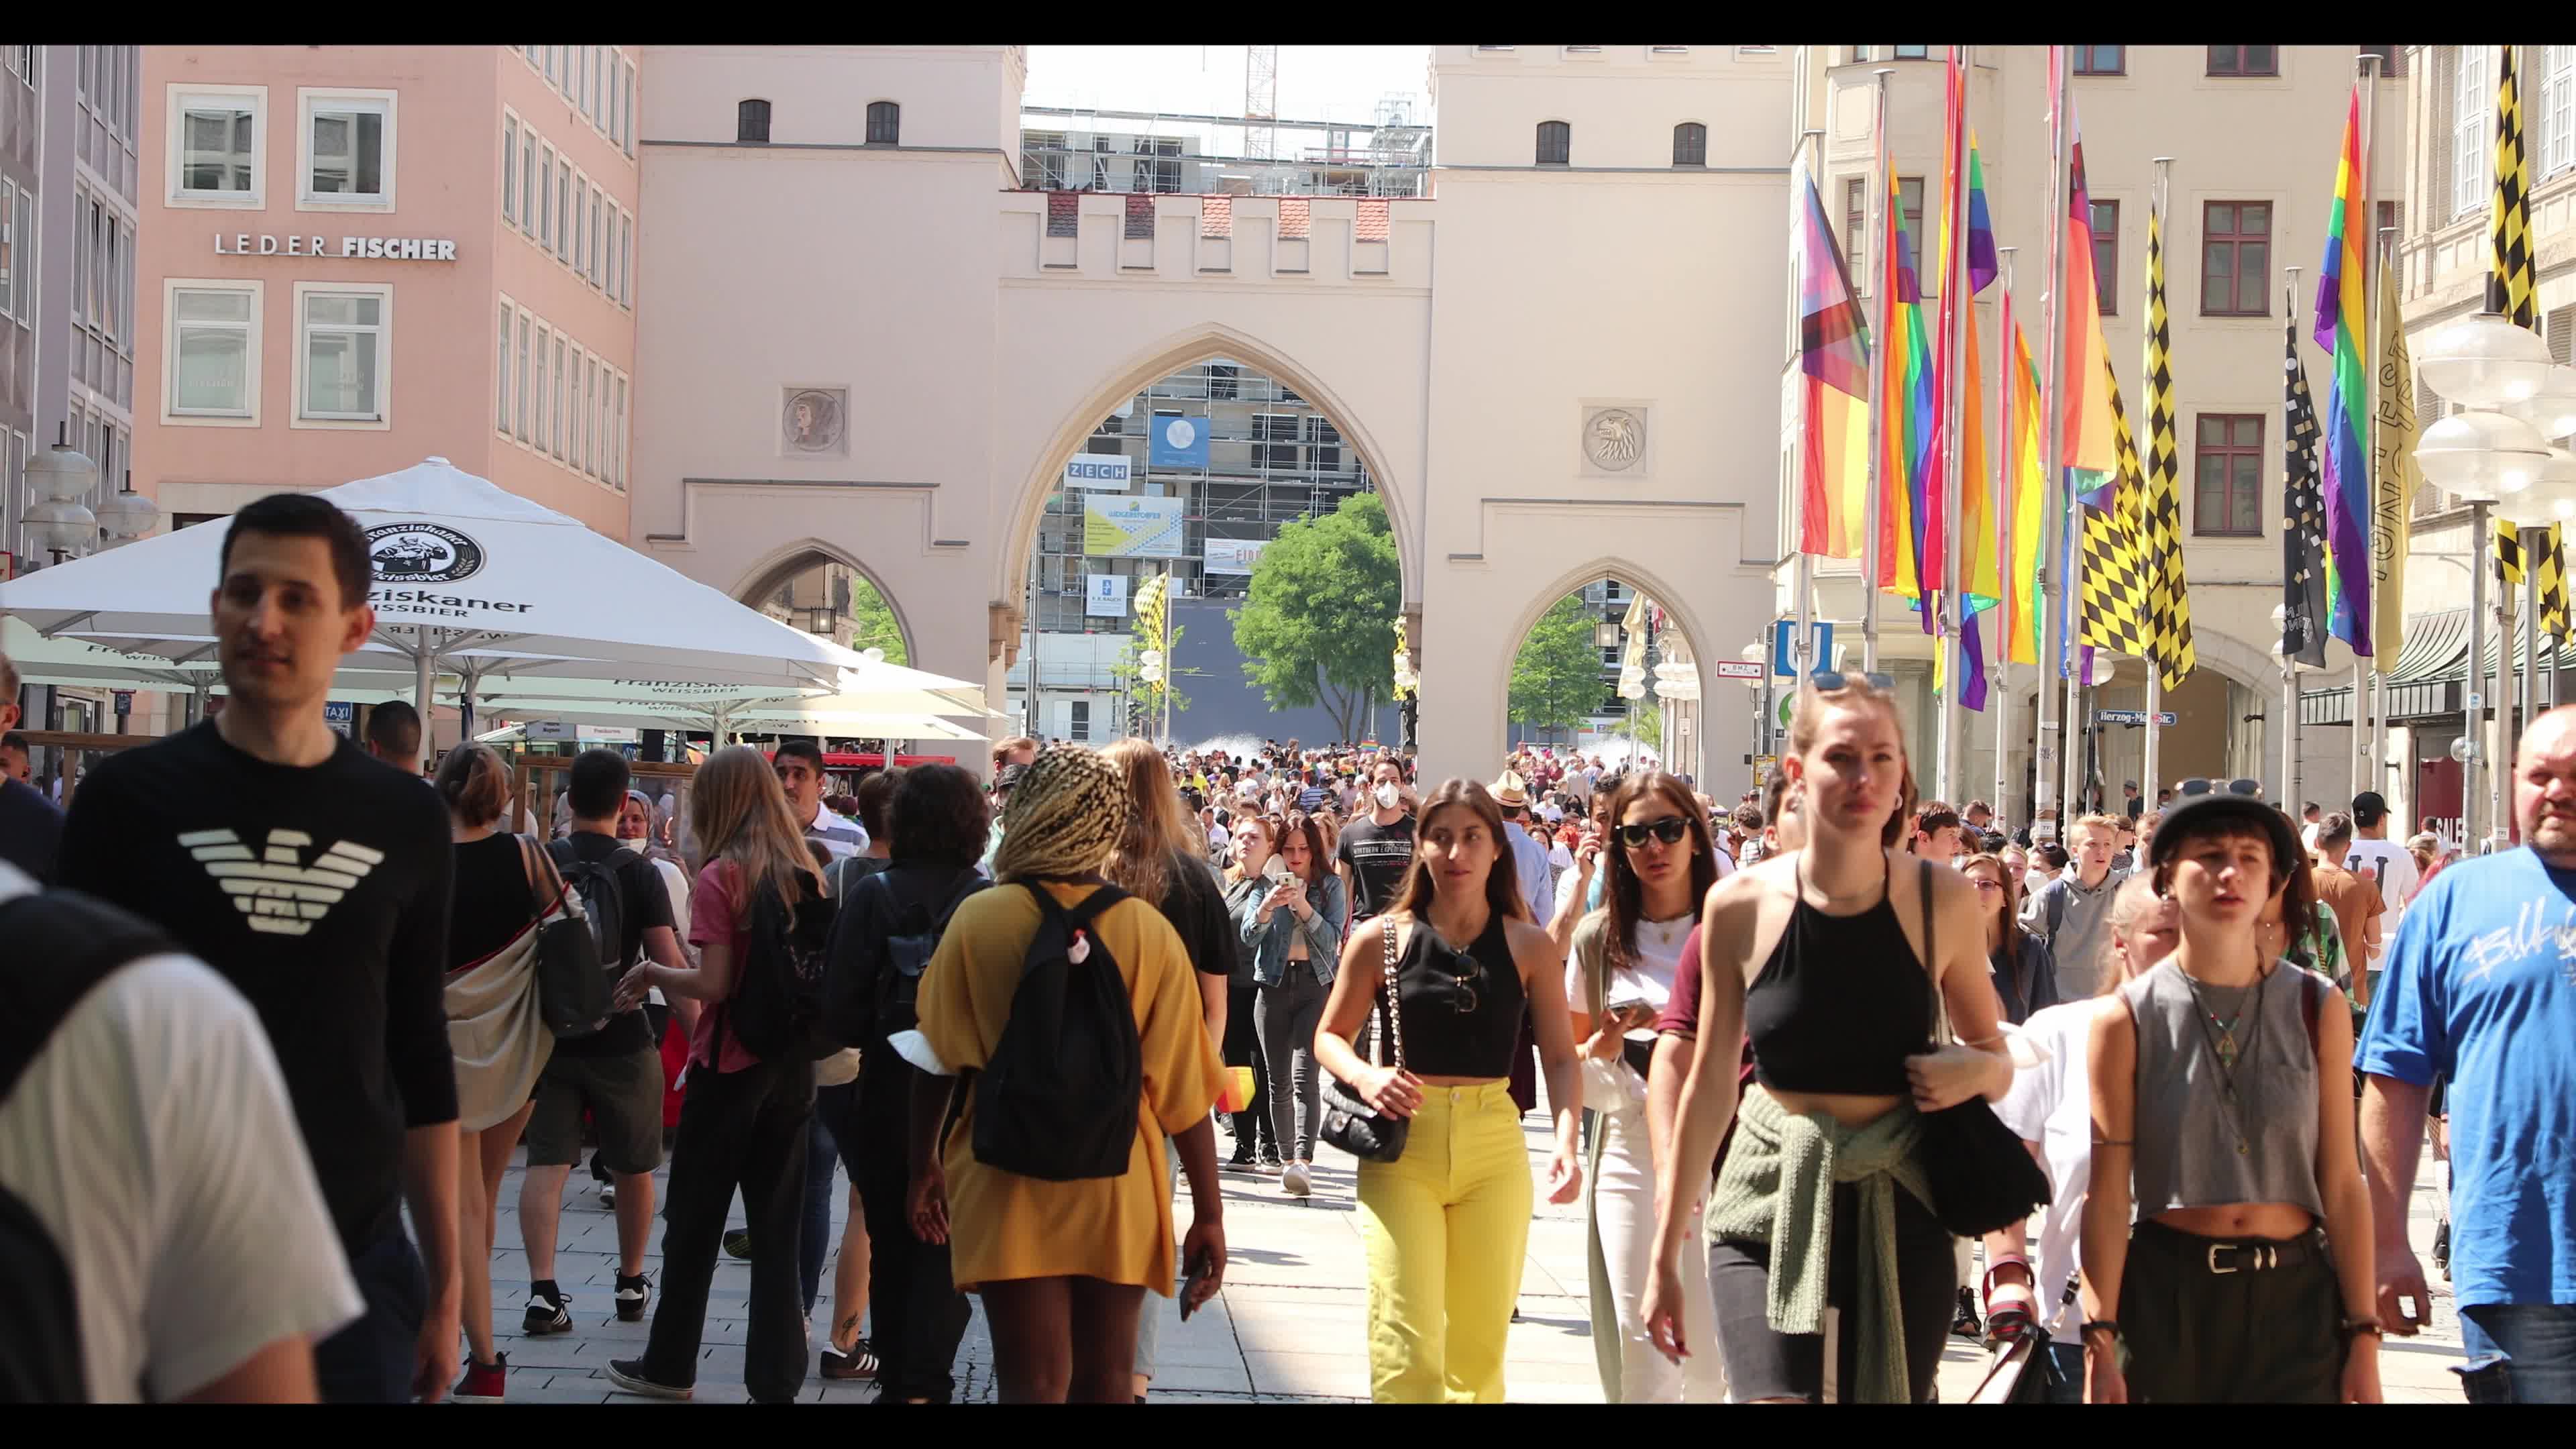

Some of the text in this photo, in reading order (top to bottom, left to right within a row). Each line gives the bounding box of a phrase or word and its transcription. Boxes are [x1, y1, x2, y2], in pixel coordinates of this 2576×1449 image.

[215, 234, 457, 260] LEDER FISCHER
[1070, 464, 1126, 479] ZECH
[366, 589, 535, 613] ziskaner
[373, 604, 469, 617] ISSBIER
[1787, 625, 1823, 673] U
[325, 707, 349, 718] TAXI
[2100, 711, 2171, 723] Herzog-MaStr.
[2436, 818, 2463, 850] SALE
